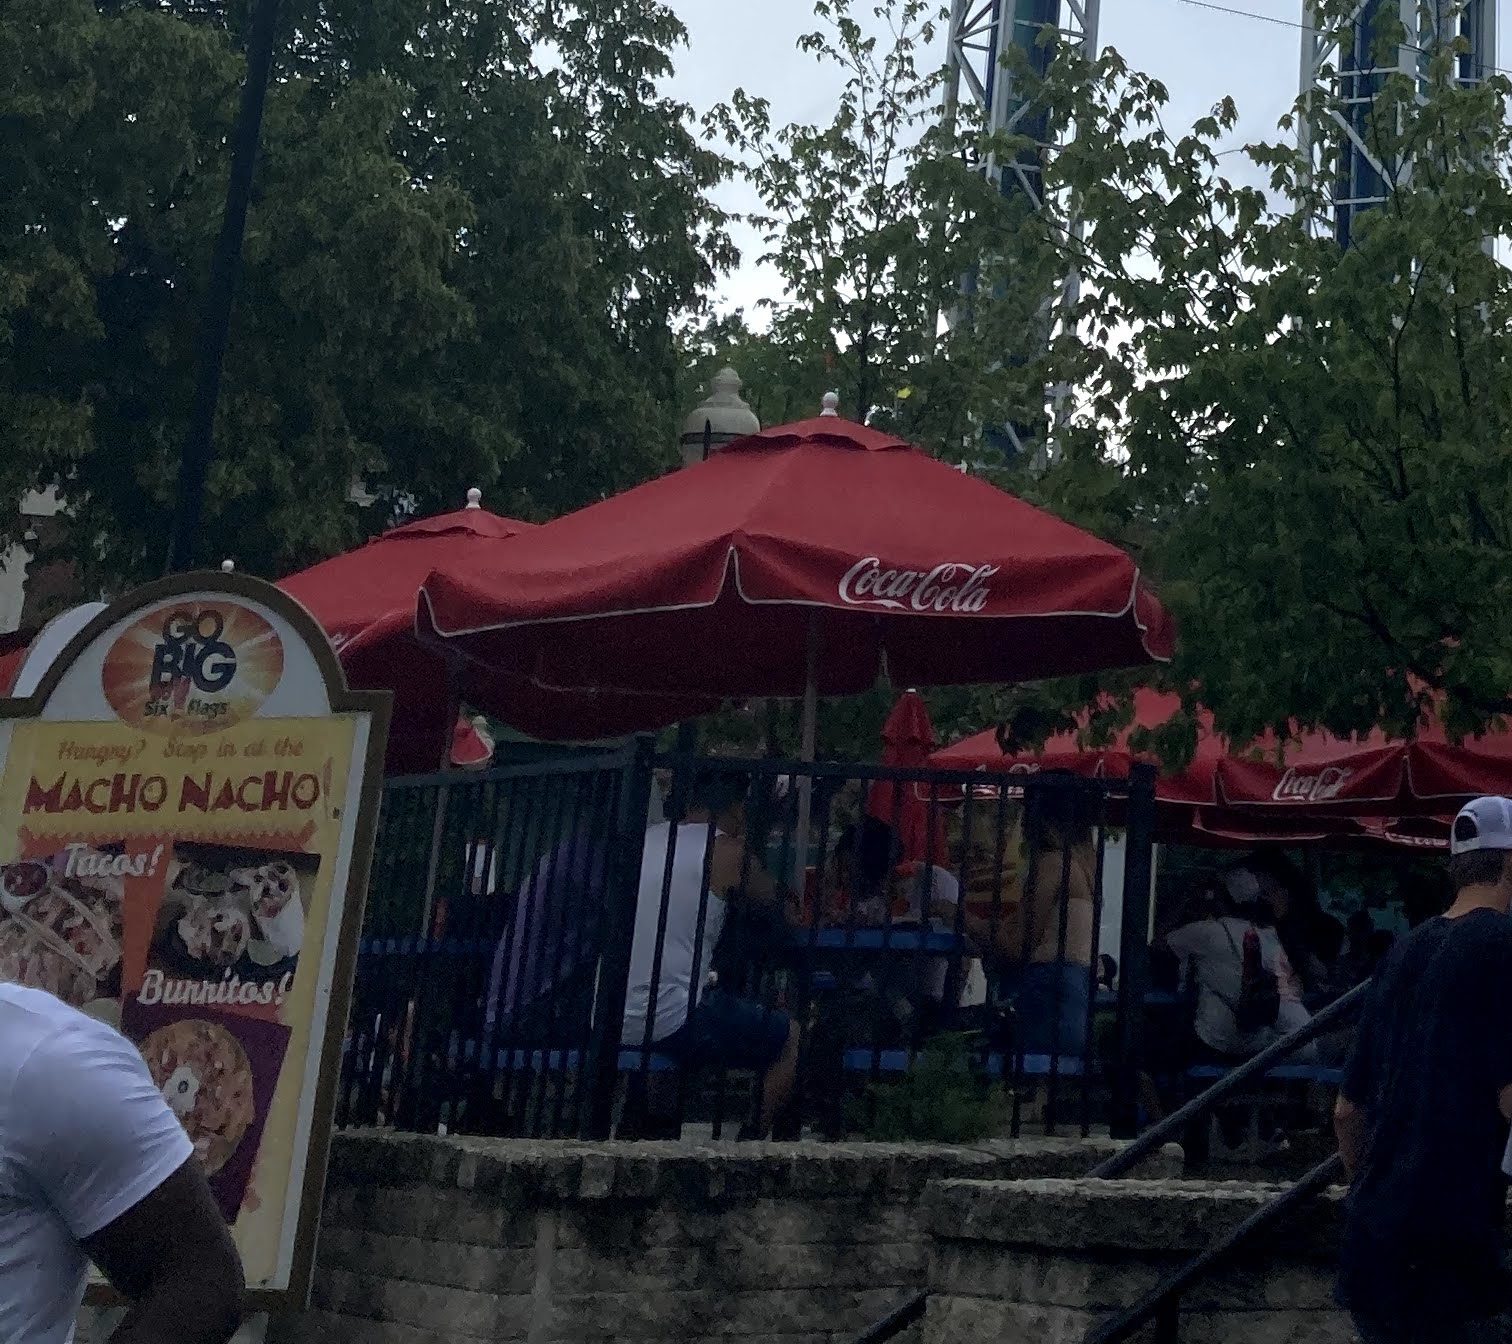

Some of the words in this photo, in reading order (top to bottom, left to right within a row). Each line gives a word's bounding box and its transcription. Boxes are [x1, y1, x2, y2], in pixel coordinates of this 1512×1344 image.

[838, 556, 1001, 612] Coca-Cola
[162, 609, 224, 643] GO
[150, 640, 237, 694] BIG
[22, 770, 168, 814] MACHO
[178, 770, 320, 813] NACHO
[64, 842, 166, 879] Tacos!
[136, 967, 294, 1006] Burritos!
